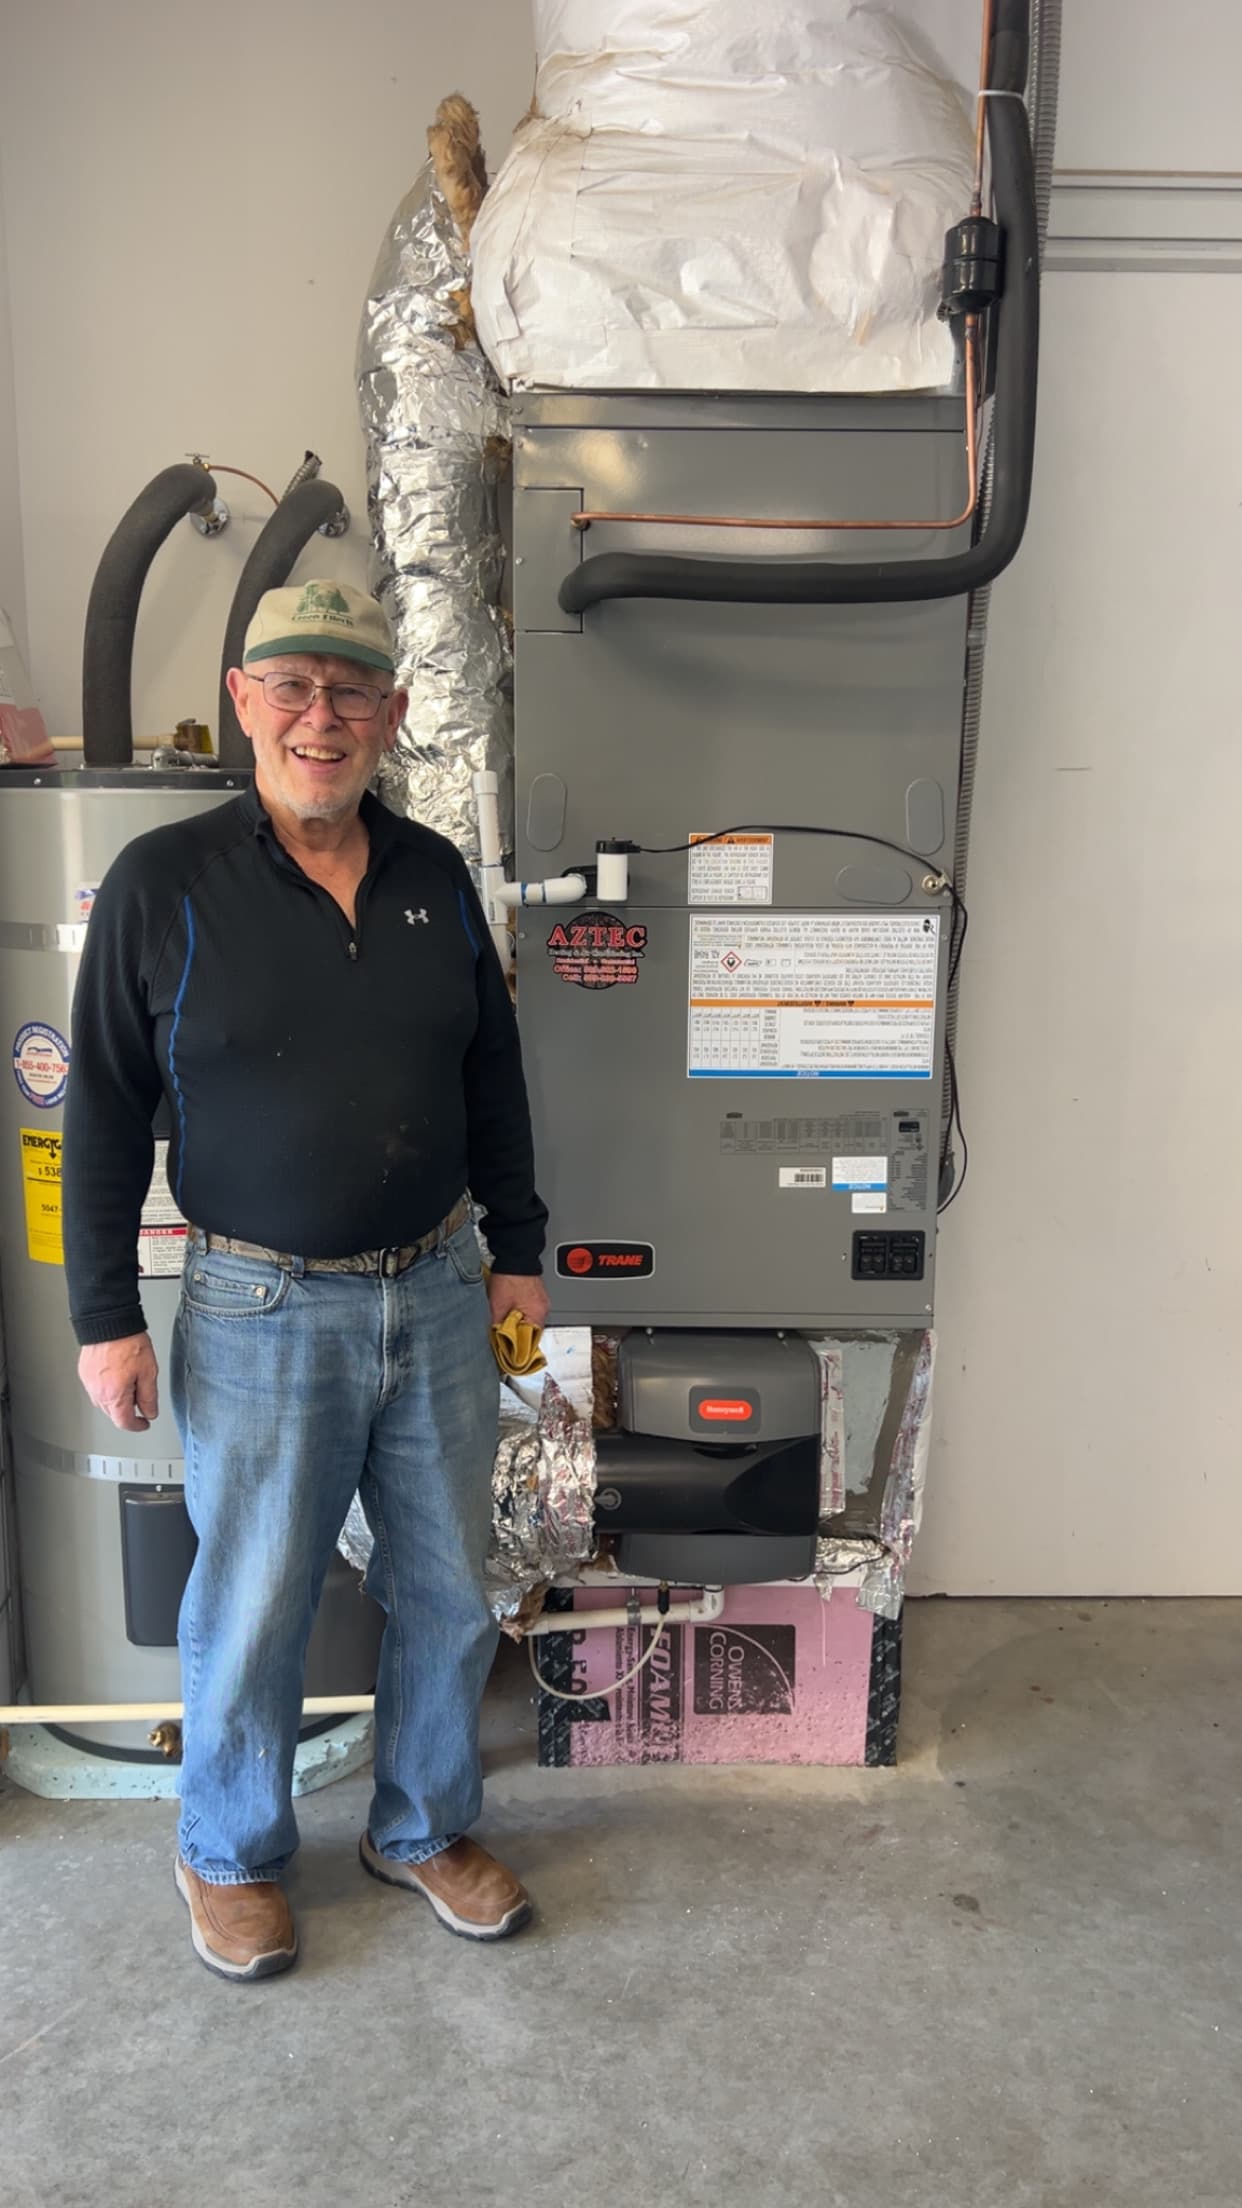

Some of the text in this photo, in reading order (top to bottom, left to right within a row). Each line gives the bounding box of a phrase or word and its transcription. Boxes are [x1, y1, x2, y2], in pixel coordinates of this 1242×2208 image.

[548, 925, 646, 948] AZTEC
[598, 1254, 644, 1266] TRANE
[706, 1405, 745, 1415] Honeywell
[709, 1632, 727, 1710] CORNING
[727, 1646, 745, 1711] OWENS
